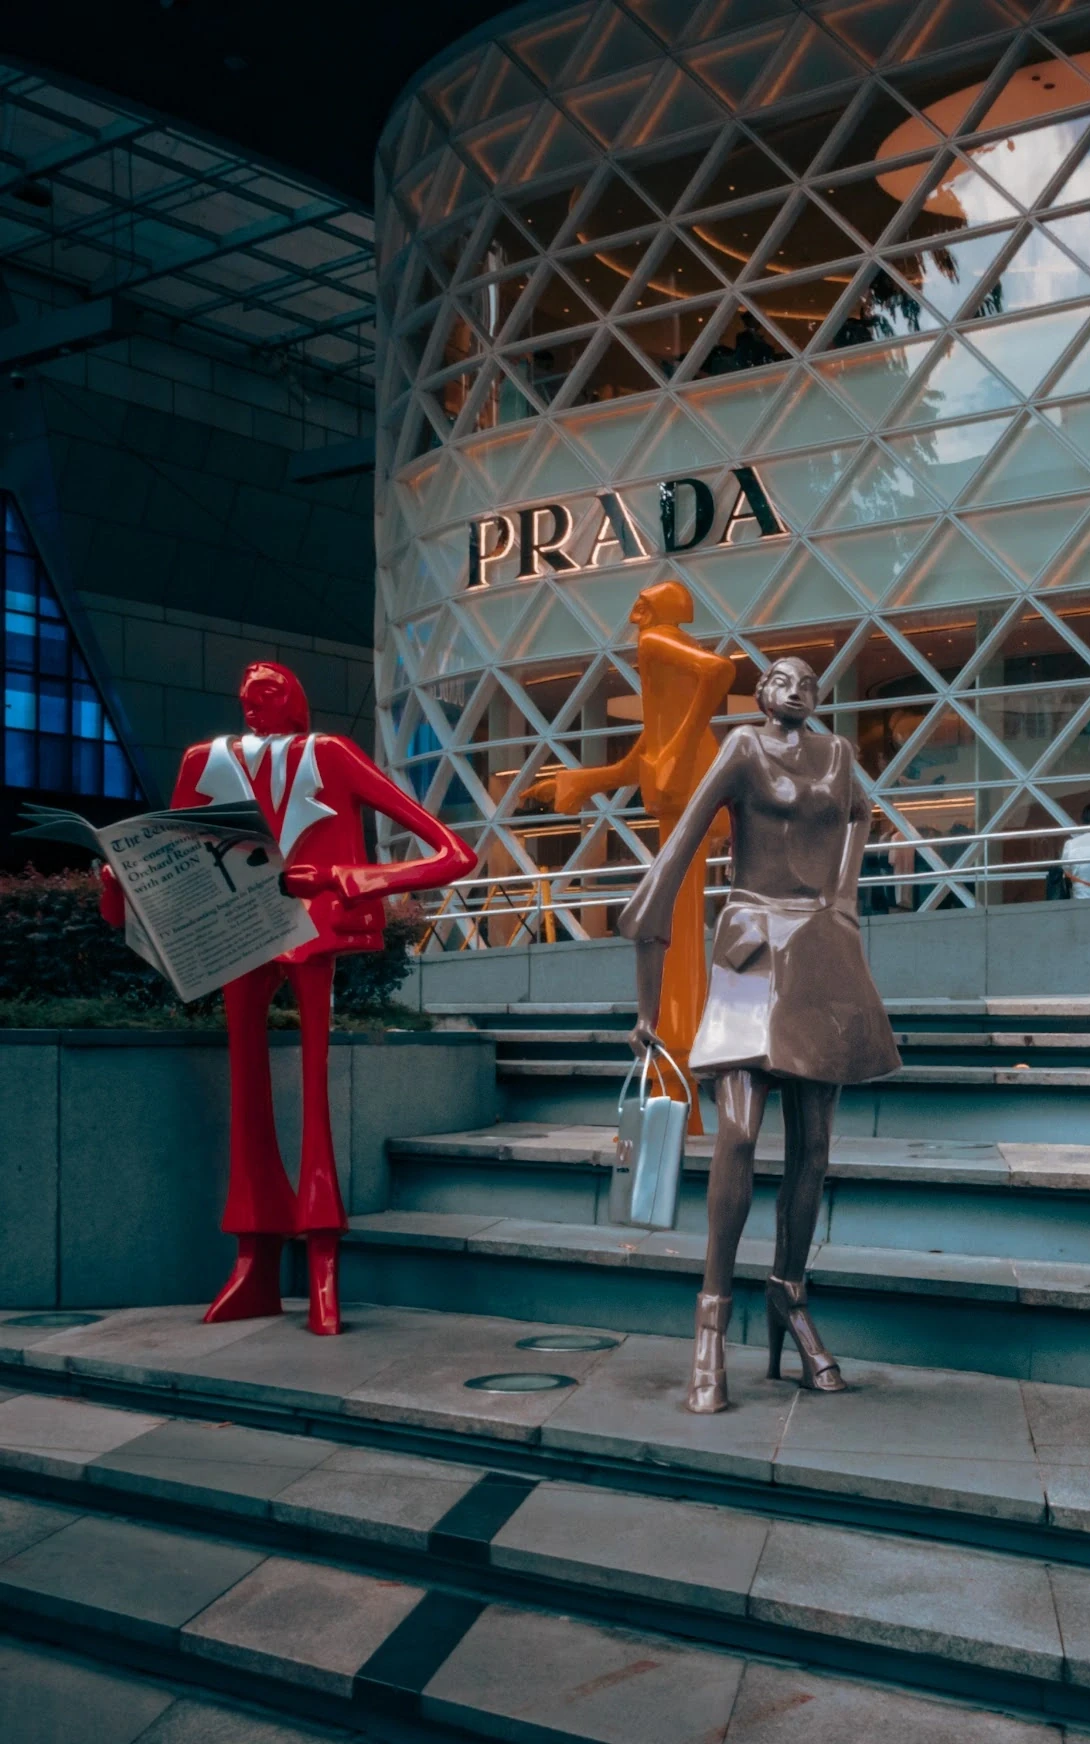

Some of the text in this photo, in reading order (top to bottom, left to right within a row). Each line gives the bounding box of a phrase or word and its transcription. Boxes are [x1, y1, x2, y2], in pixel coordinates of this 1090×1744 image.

[466, 466, 791, 591] PRADA
[111, 834, 140, 853] The
[127, 840, 202, 882] Orchard Road
[134, 853, 201, 894] with an ION
